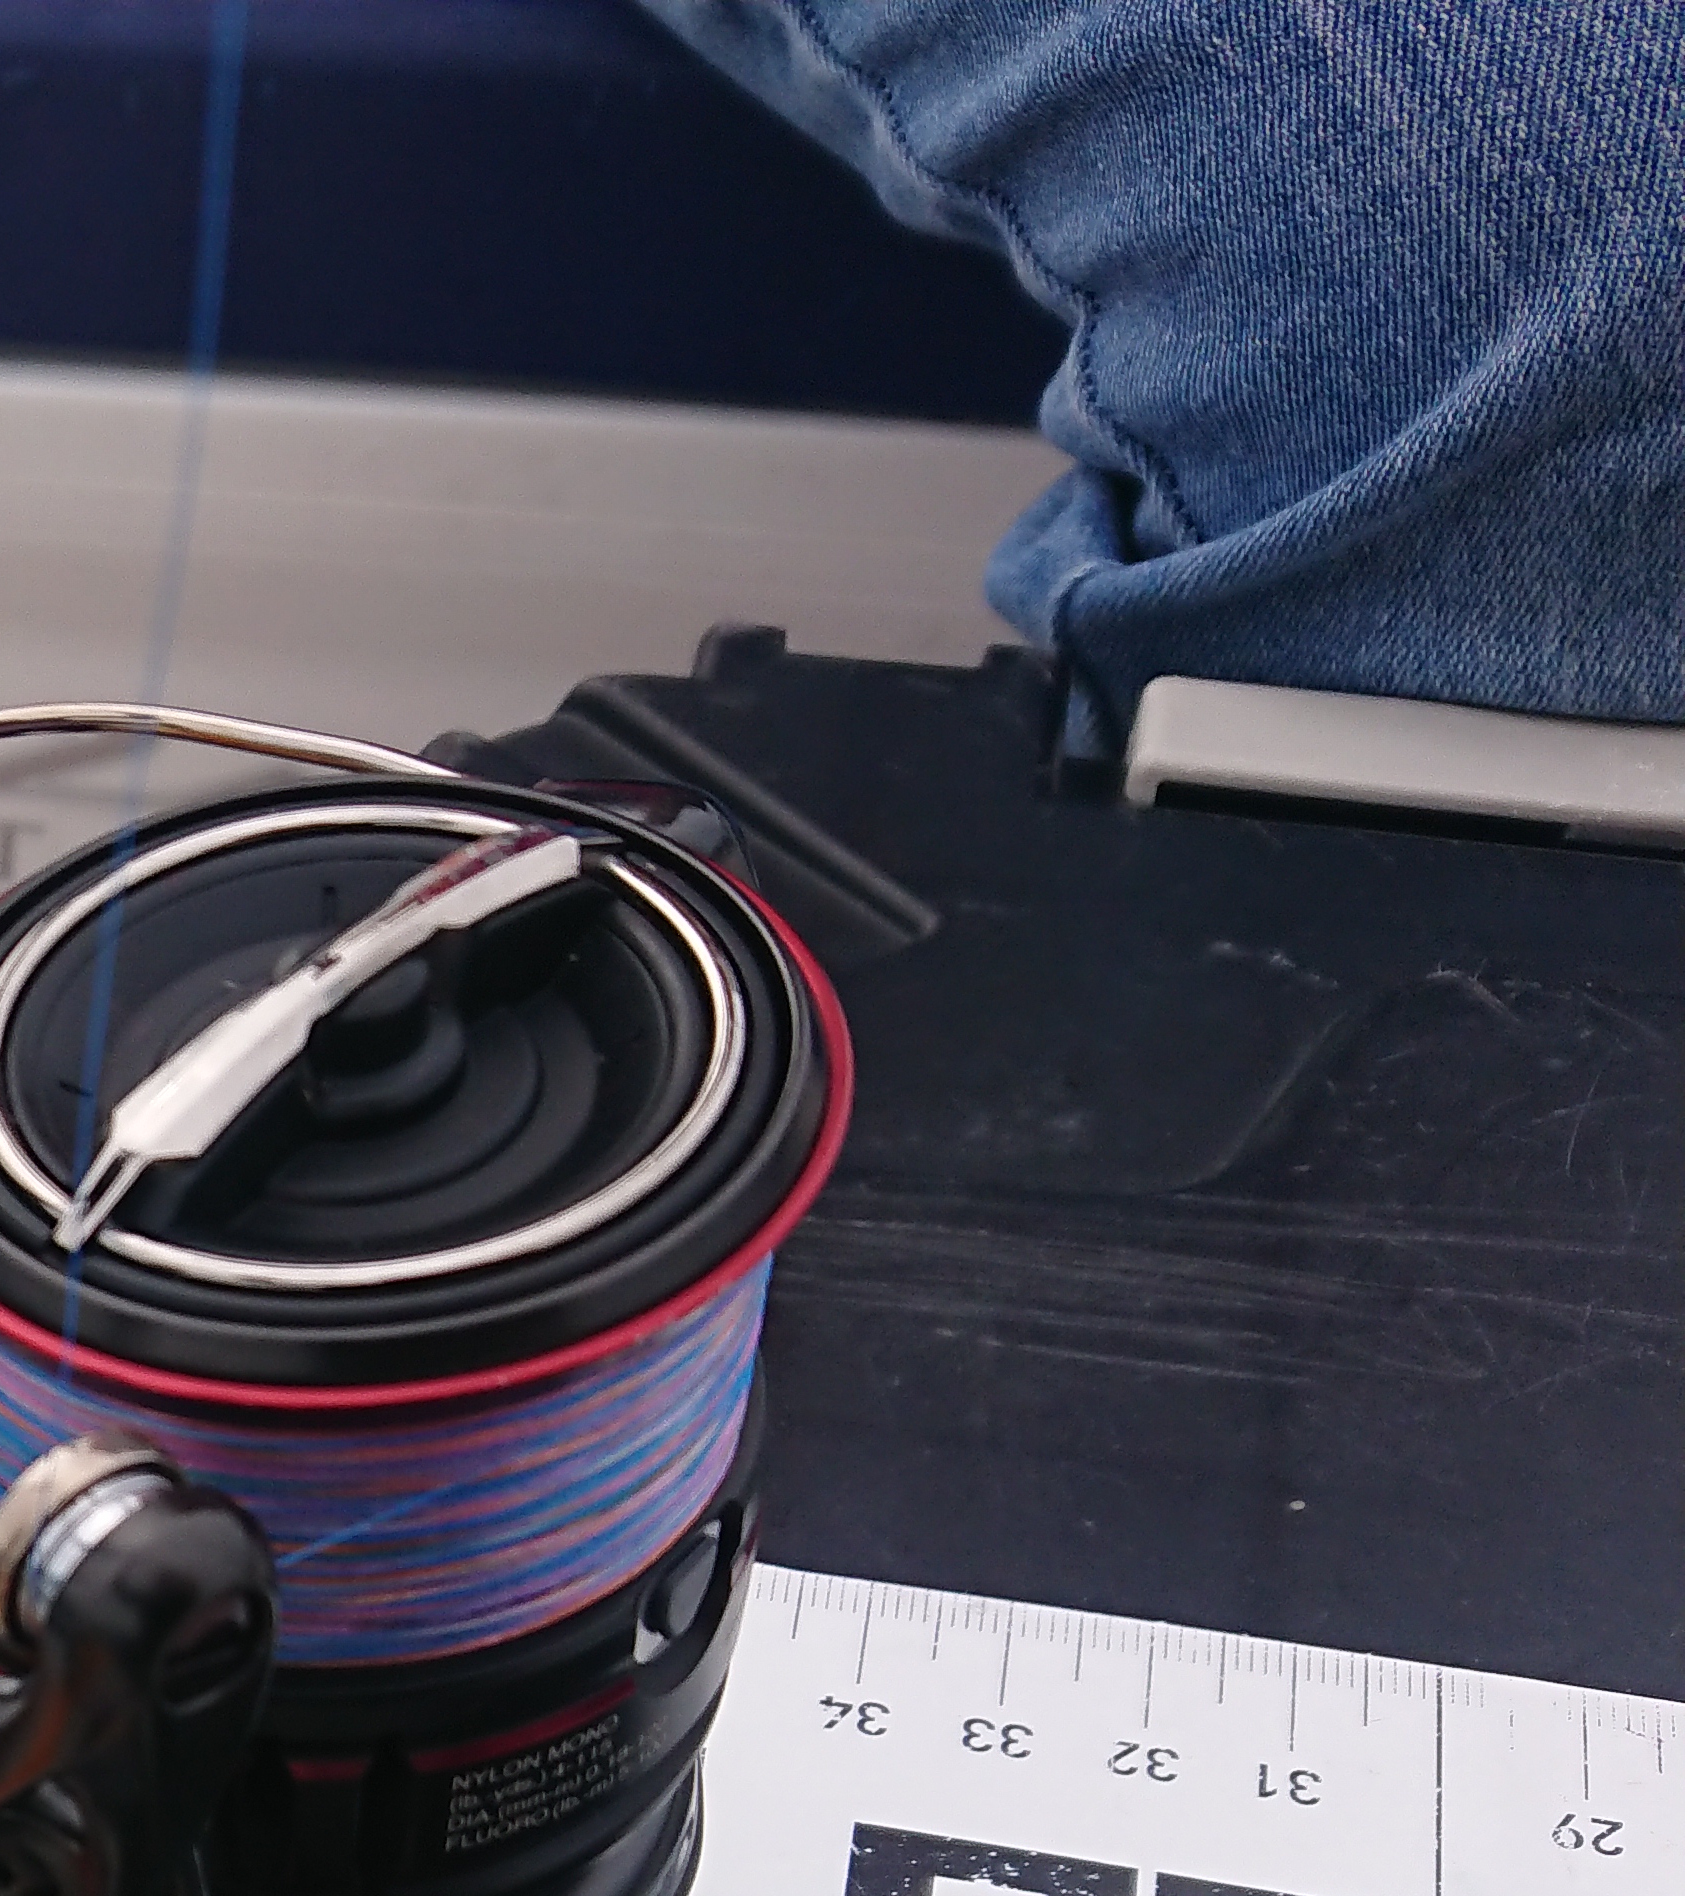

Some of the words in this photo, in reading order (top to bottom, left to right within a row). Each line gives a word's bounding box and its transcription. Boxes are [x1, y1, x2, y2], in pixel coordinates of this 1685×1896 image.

[818, 1695, 891, 1737] 34
[451, 1749, 541, 1791] NYLON
[547, 1713, 621, 1762] MONO
[961, 1717, 1034, 1759] 33
[1107, 1740, 1180, 1783] 32
[1255, 1762, 1323, 1806] 31
[1550, 1812, 1625, 1857] 29
